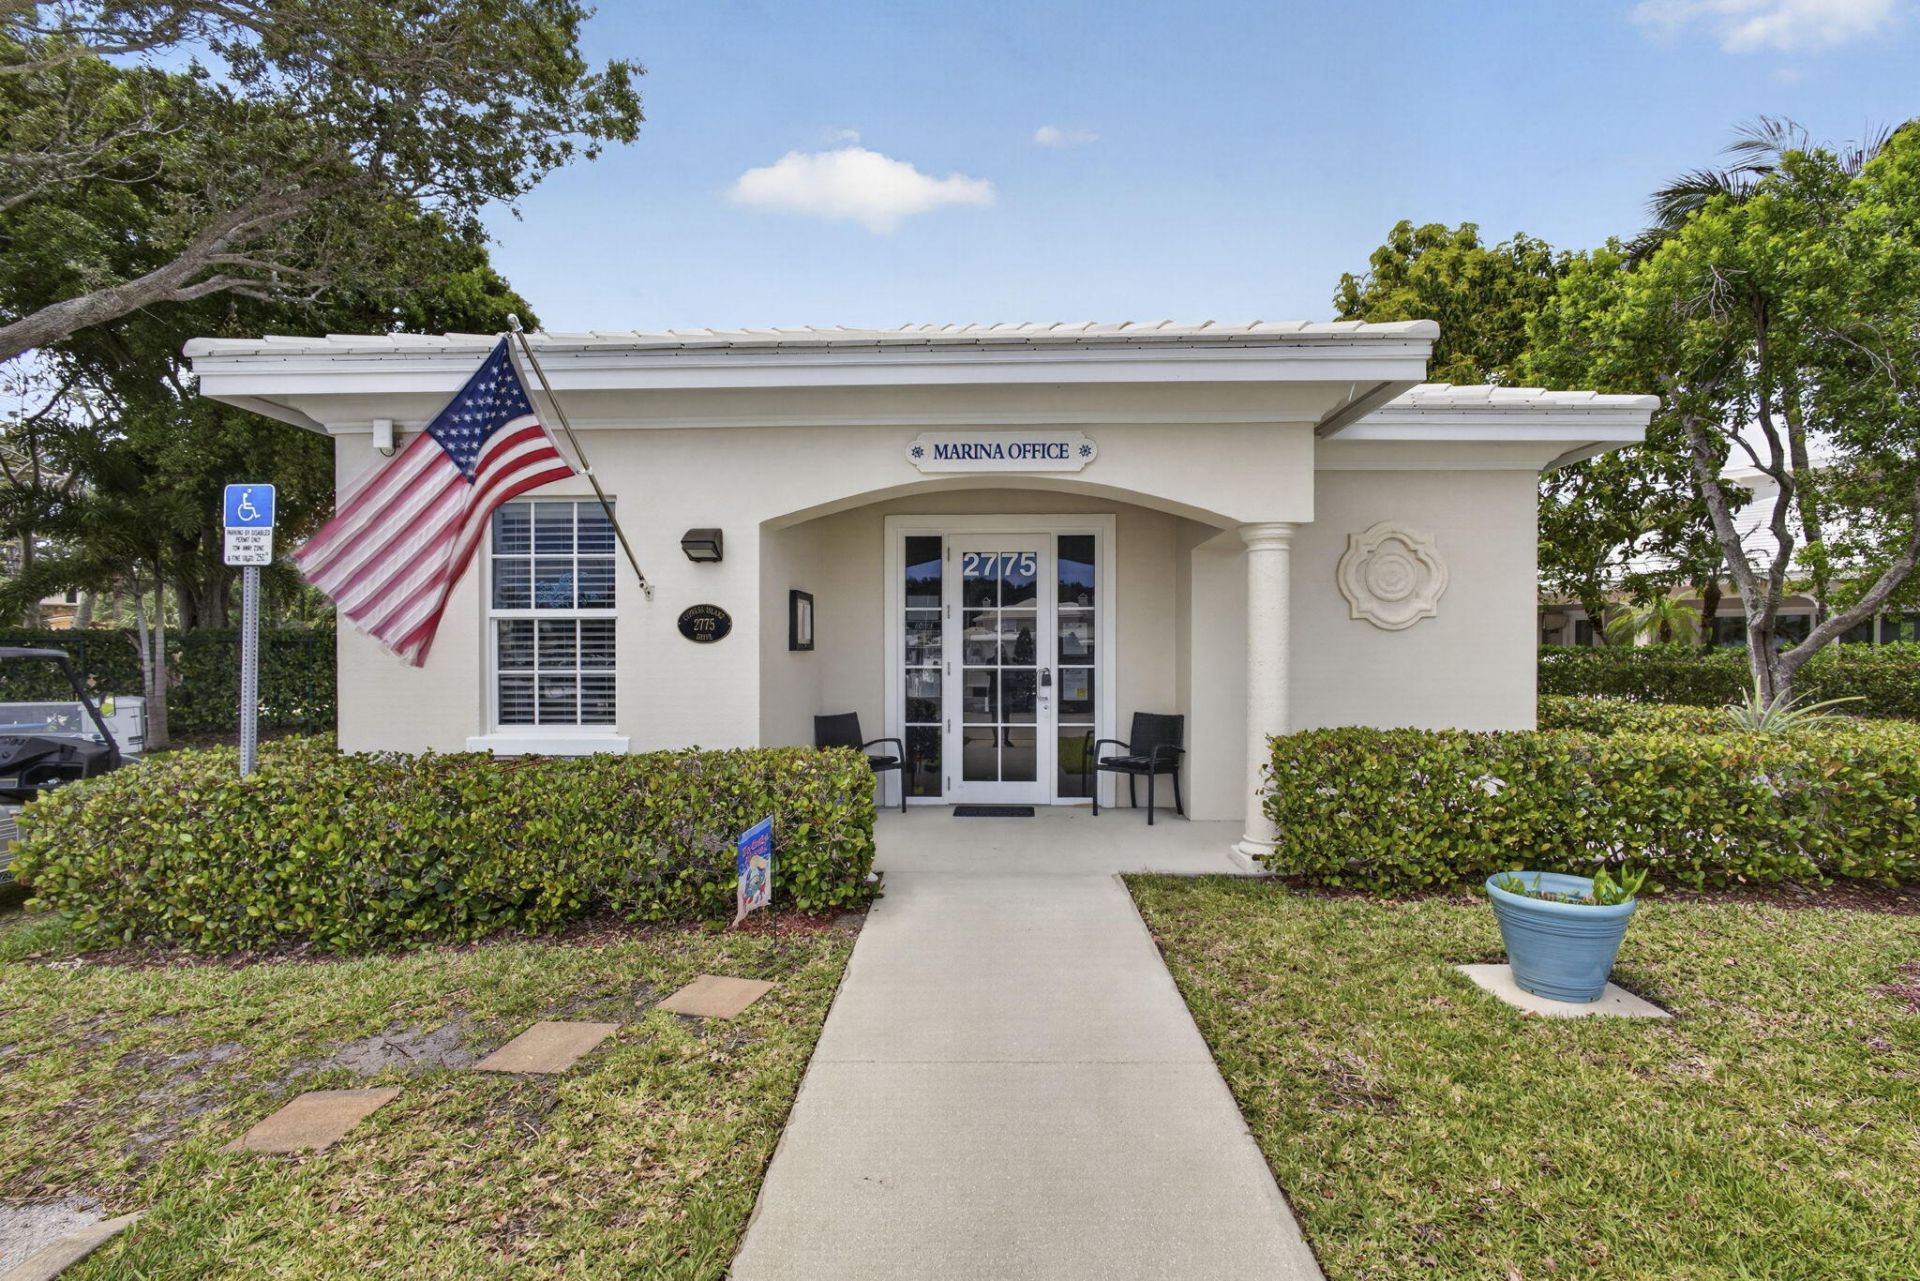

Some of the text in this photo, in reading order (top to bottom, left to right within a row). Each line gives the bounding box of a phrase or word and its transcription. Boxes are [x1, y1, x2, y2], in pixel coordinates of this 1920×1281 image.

[934, 442, 1070, 460] MARINA OFFICE
[963, 552, 1037, 577] 2775
[693, 617, 716, 631] 2775
